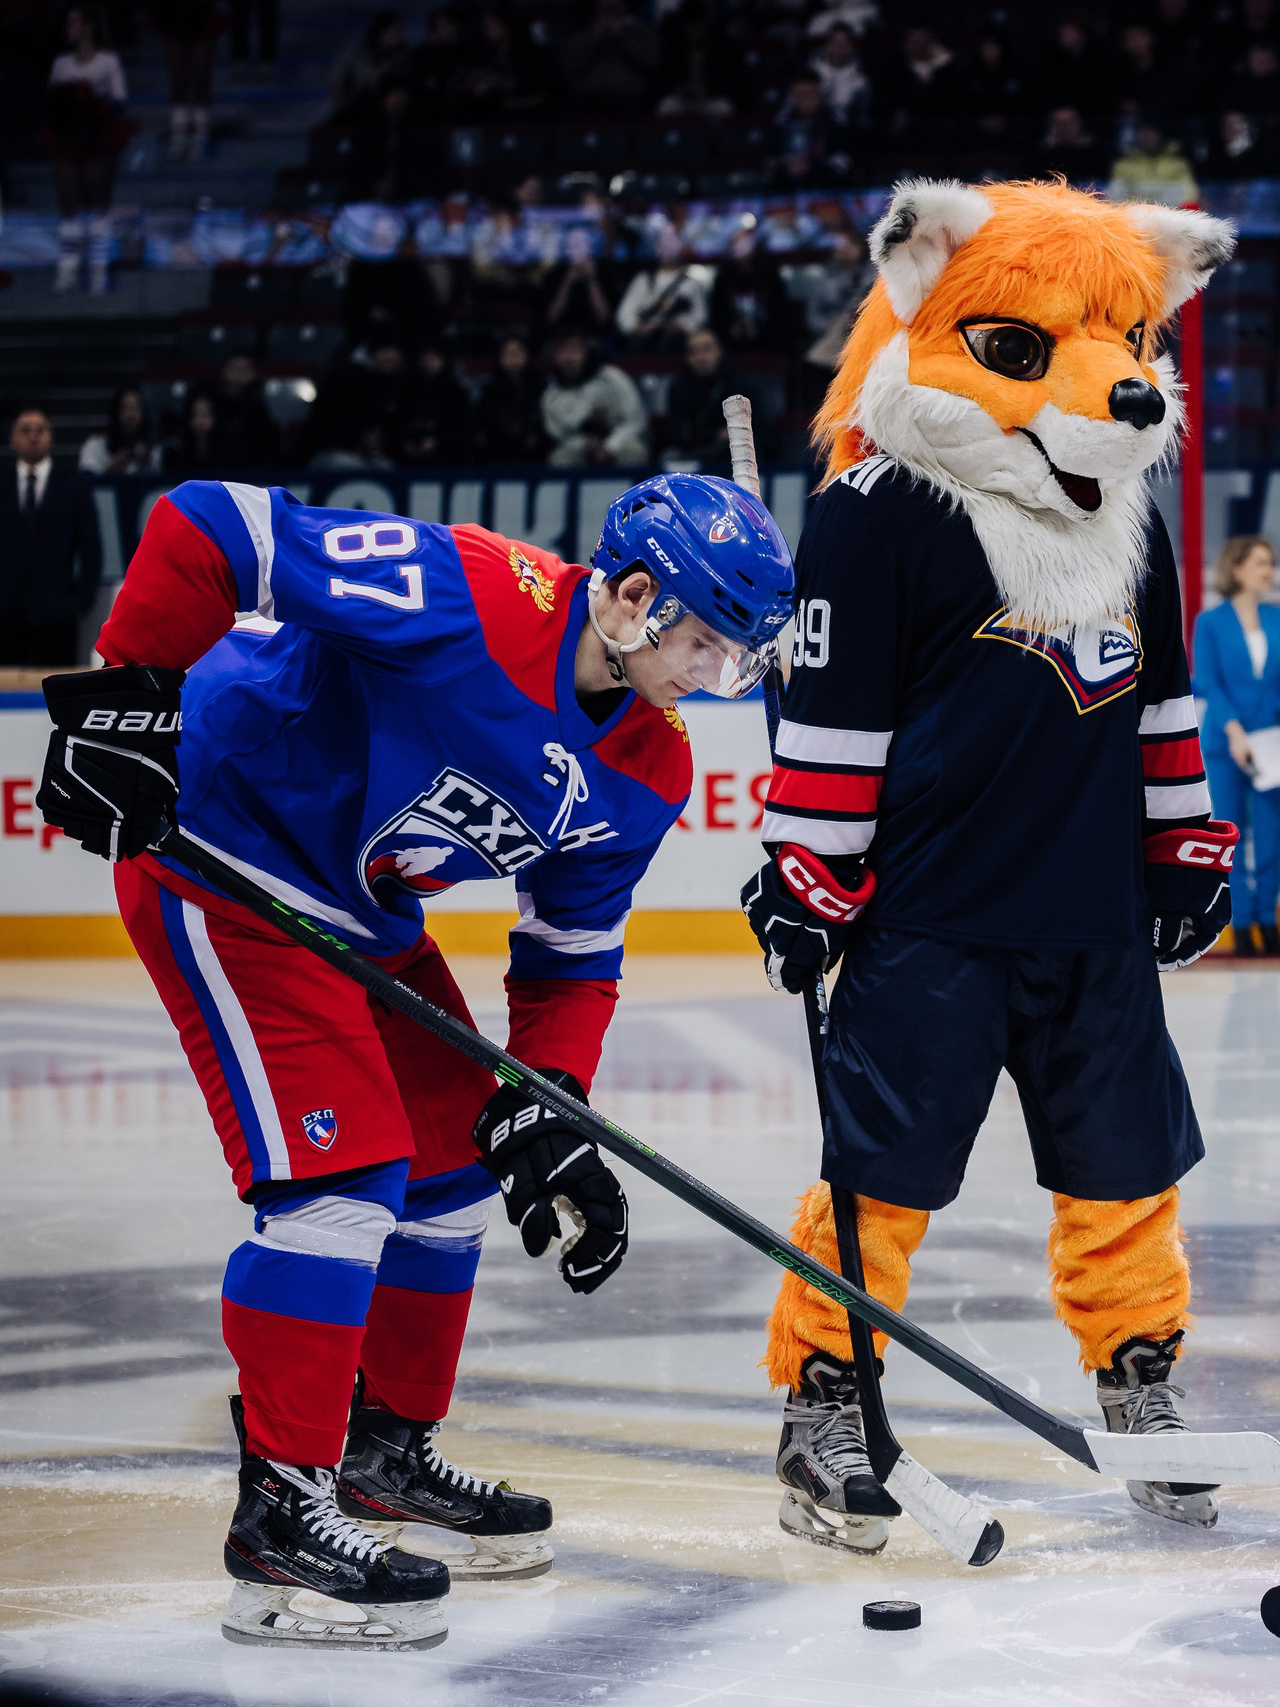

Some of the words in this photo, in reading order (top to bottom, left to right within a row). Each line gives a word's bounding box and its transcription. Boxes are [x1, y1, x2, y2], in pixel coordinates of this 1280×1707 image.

[321, 520, 429, 613] 87
[647, 536, 679, 575] CCM
[764, 615, 787, 625] CC
[272, 900, 349, 950] CCM
[1153, 917, 1162, 948] CCM
[394, 980, 422, 1001] ZAMULA
[296, 1549, 335, 1573] BAUER
